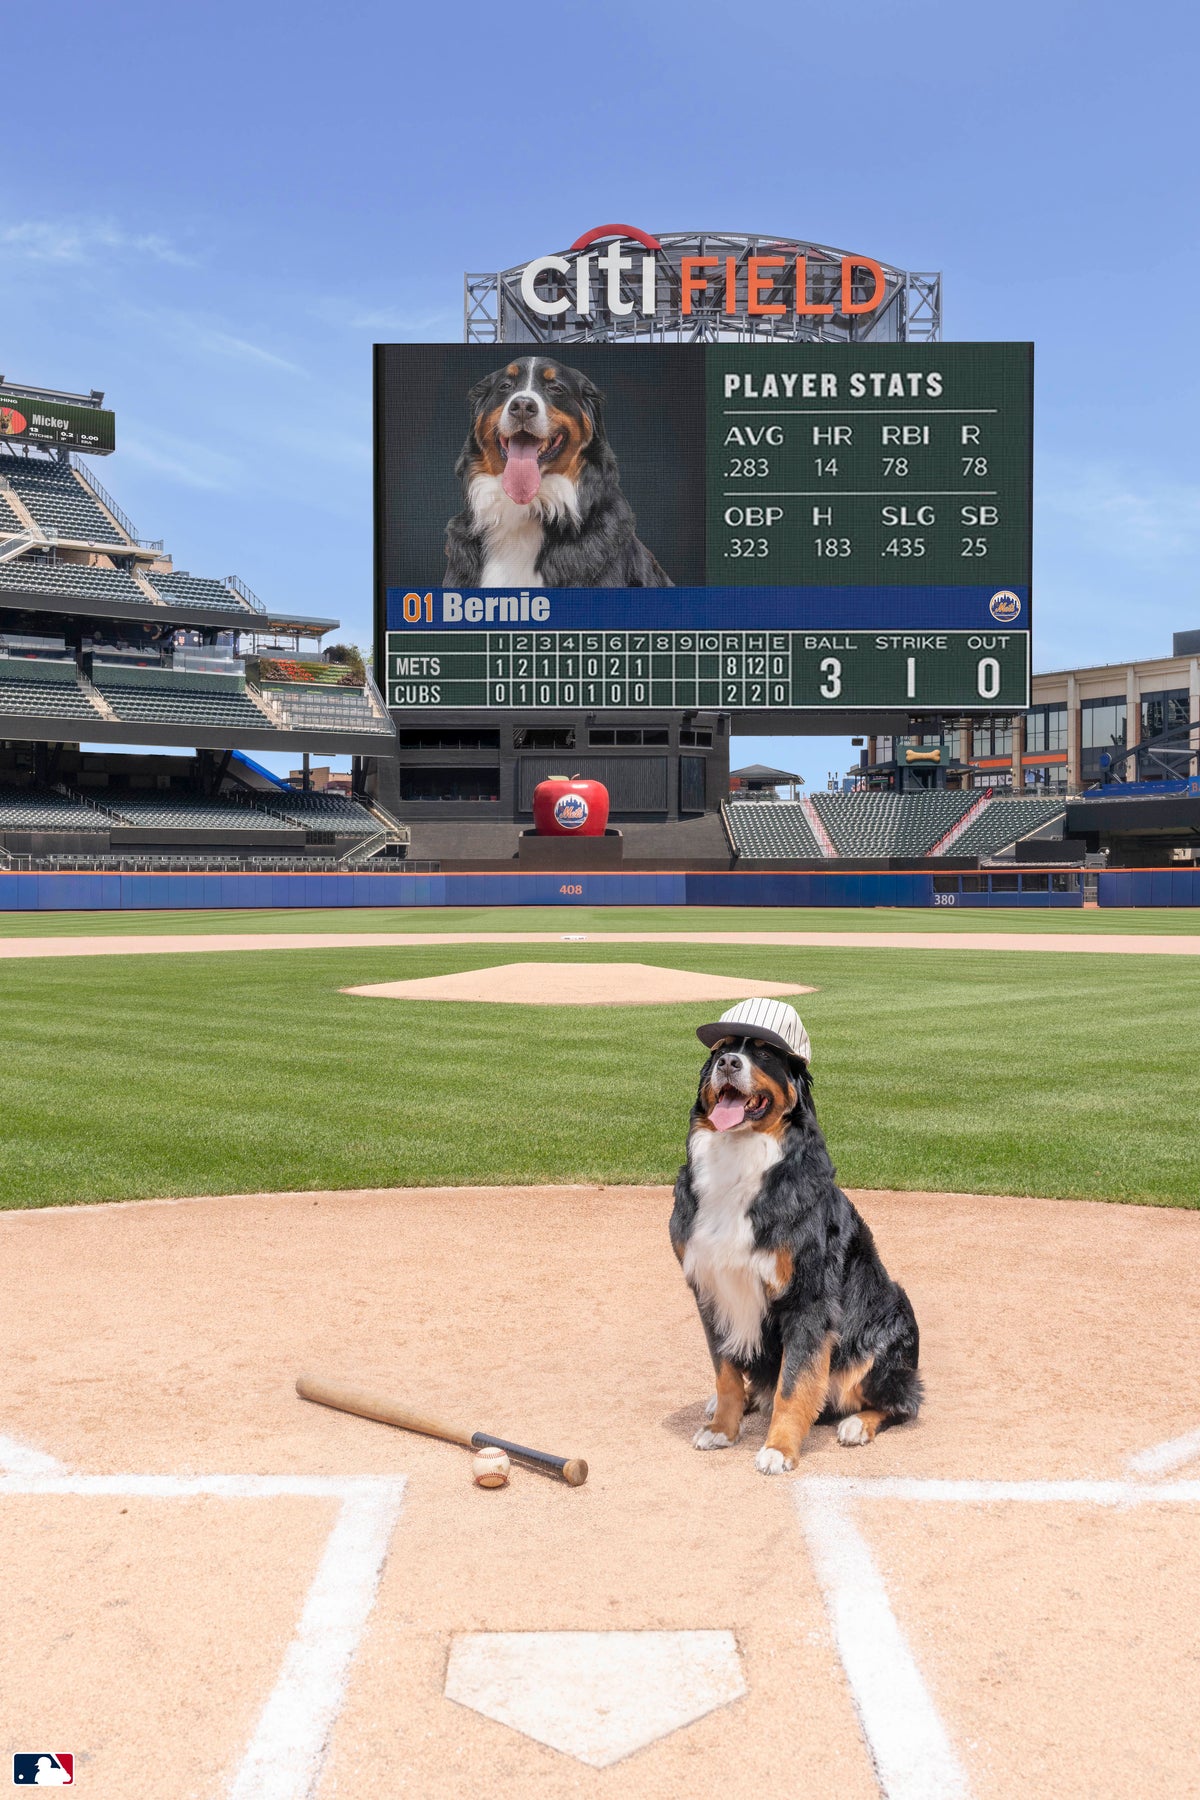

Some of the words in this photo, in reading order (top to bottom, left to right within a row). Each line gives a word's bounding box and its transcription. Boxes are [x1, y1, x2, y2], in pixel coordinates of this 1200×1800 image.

[521, 238, 656, 315] citi
[682, 256, 886, 315] FIELD
[725, 374, 837, 397] PLAYER
[850, 373, 942, 397] STATS
[32, 414, 69, 430] Mickey
[725, 426, 783, 445] AVG
[814, 427, 852, 445] HR
[883, 426, 928, 444] RBI
[962, 426, 979, 444] R
[724, 459, 768, 477] .283
[815, 459, 838, 476] 14
[883, 458, 908, 476] 78
[962, 457, 987, 475] 78
[725, 507, 783, 526] OBP
[814, 507, 831, 525] H
[883, 506, 934, 525] SLG
[962, 507, 998, 525] SB
[724, 539, 768, 557] .323
[815, 539, 851, 556] 183
[882, 538, 925, 556] .435
[962, 538, 986, 556] 25
[403, 593, 432, 622] 01
[443, 592, 550, 622] Bernie
[498, 638, 503, 649] 1
[517, 637, 527, 649] 2
[540, 637, 551, 649] 3
[563, 638, 574, 649] 4
[587, 637, 598, 649] 5
[610, 637, 621, 649] 6
[634, 637, 645, 649] 7
[657, 637, 668, 649] 8
[680, 637, 692, 649] 9
[700, 637, 717, 649] 10
[726, 637, 738, 649] R
[749, 637, 762, 649] H
[773, 637, 784, 649] E
[805, 637, 857, 649] BALL
[876, 637, 947, 649] STRIKE
[968, 636, 1009, 649] OUT
[397, 658, 440, 675] METS
[496, 659, 503, 676] 1
[519, 659, 527, 676] 2
[542, 659, 549, 676] 1
[566, 659, 573, 676] 1
[588, 659, 597, 676] 0
[611, 658, 619, 675] 2
[635, 659, 642, 676] 1
[727, 657, 736, 675] 8
[748, 657, 764, 674] 12
[774, 657, 782, 674] 0
[821, 658, 841, 698] 3
[907, 658, 916, 697] 1
[978, 658, 999, 698] 0
[395, 685, 440, 703] CUBS
[496, 684, 504, 702] 0
[519, 684, 526, 702] 1
[541, 685, 549, 703] 0
[565, 684, 573, 702] 0
[587, 684, 595, 702] 1
[612, 685, 620, 702] 0
[635, 684, 644, 701] 0
[728, 685, 736, 701] 2
[752, 685, 760, 701] 2
[775, 685, 784, 701] 0
[560, 885, 582, 894] 408
[935, 895, 954, 905] 380
